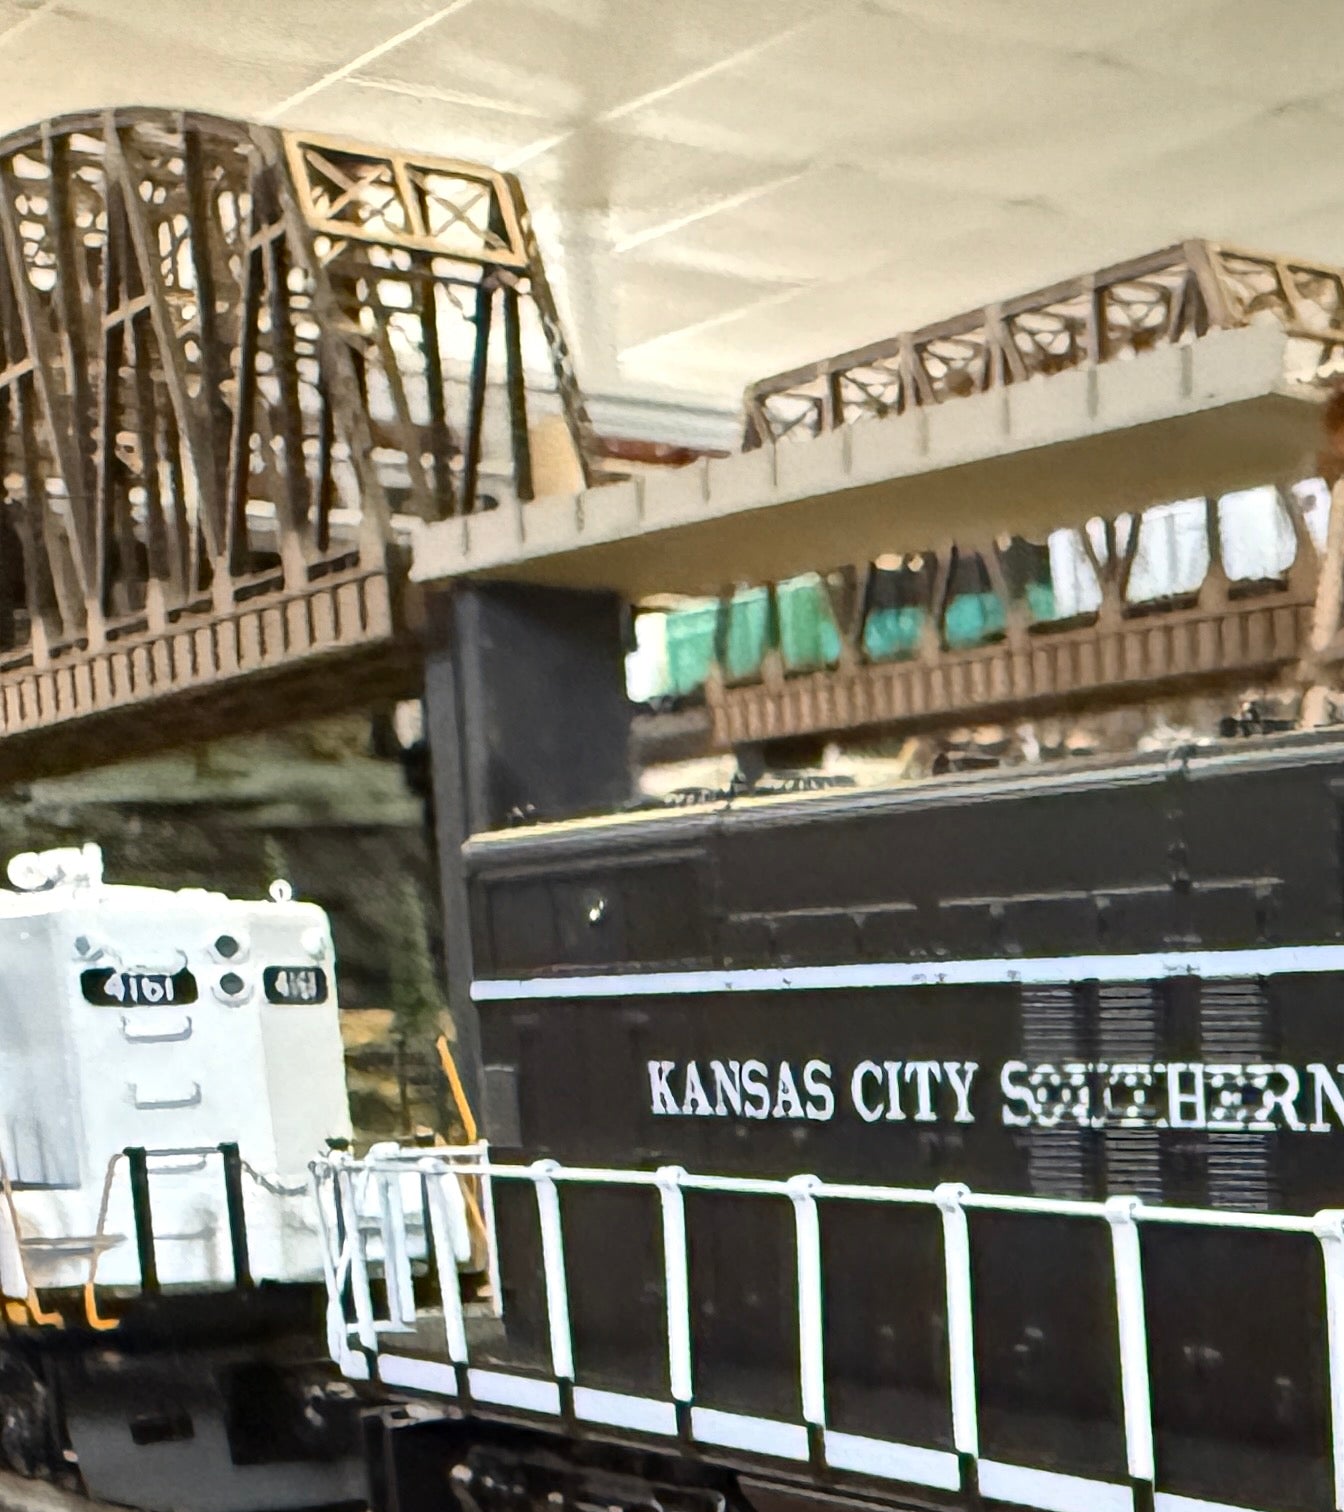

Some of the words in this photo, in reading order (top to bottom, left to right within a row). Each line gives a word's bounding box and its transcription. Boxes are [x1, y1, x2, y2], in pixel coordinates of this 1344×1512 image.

[103, 973, 175, 1003] 4161
[647, 1058, 836, 1122] KANSAS
[850, 1059, 980, 1124] CITY
